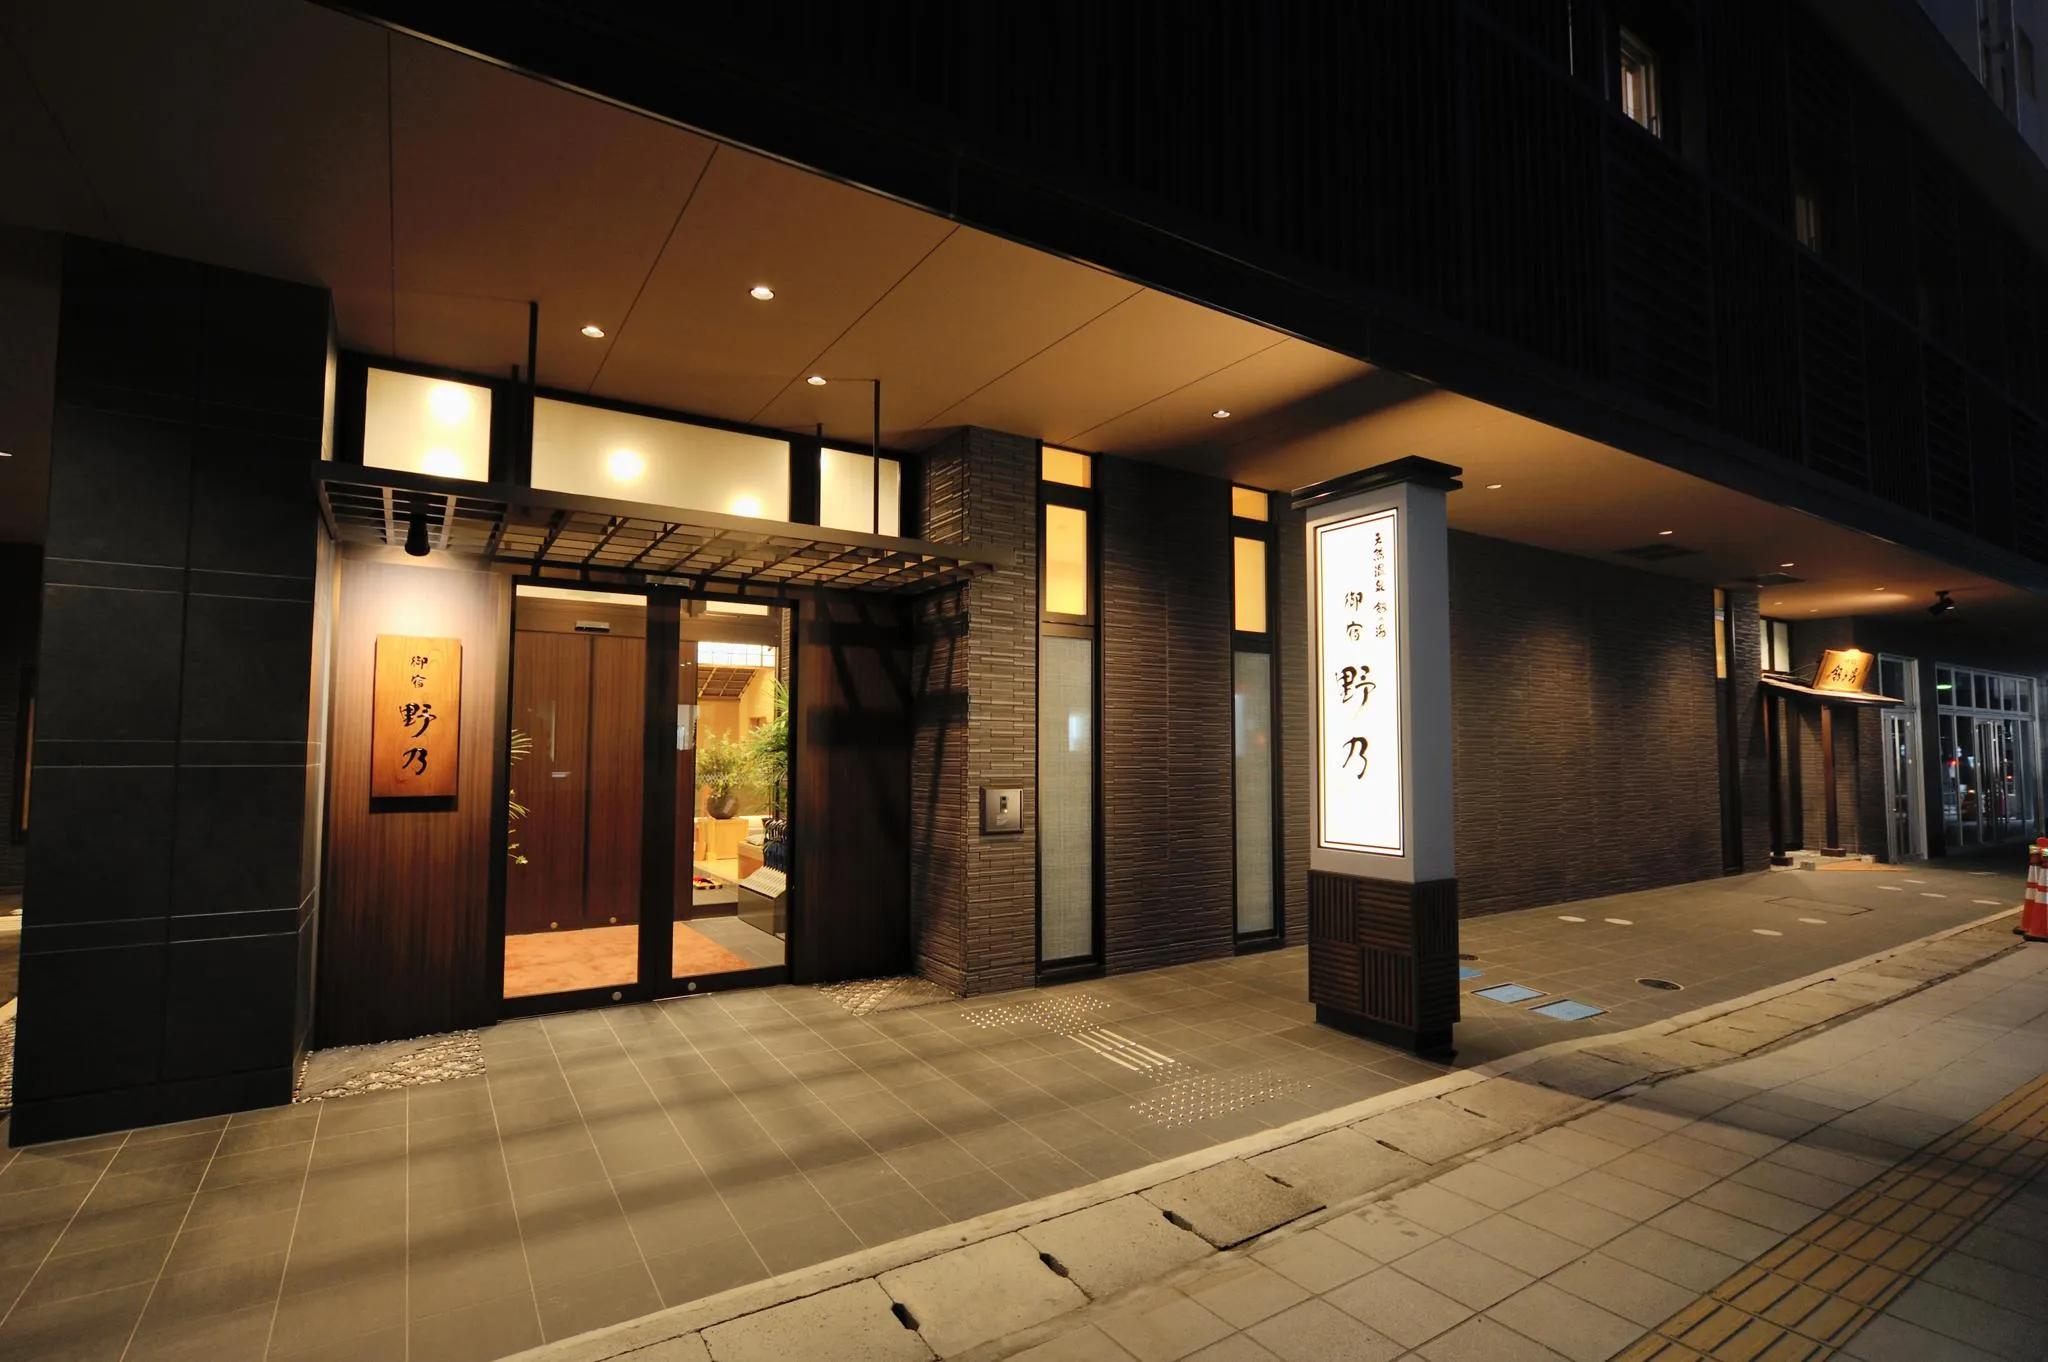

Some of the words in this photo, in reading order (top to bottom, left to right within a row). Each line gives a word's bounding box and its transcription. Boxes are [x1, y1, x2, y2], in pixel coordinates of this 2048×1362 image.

[1373, 532, 1386, 592] 天然温泉
[1344, 591, 1363, 641] 御宿
[411, 655, 429, 689] 御宿
[398, 702, 437, 776] 野乃
[1334, 665, 1376, 779] 野乃
